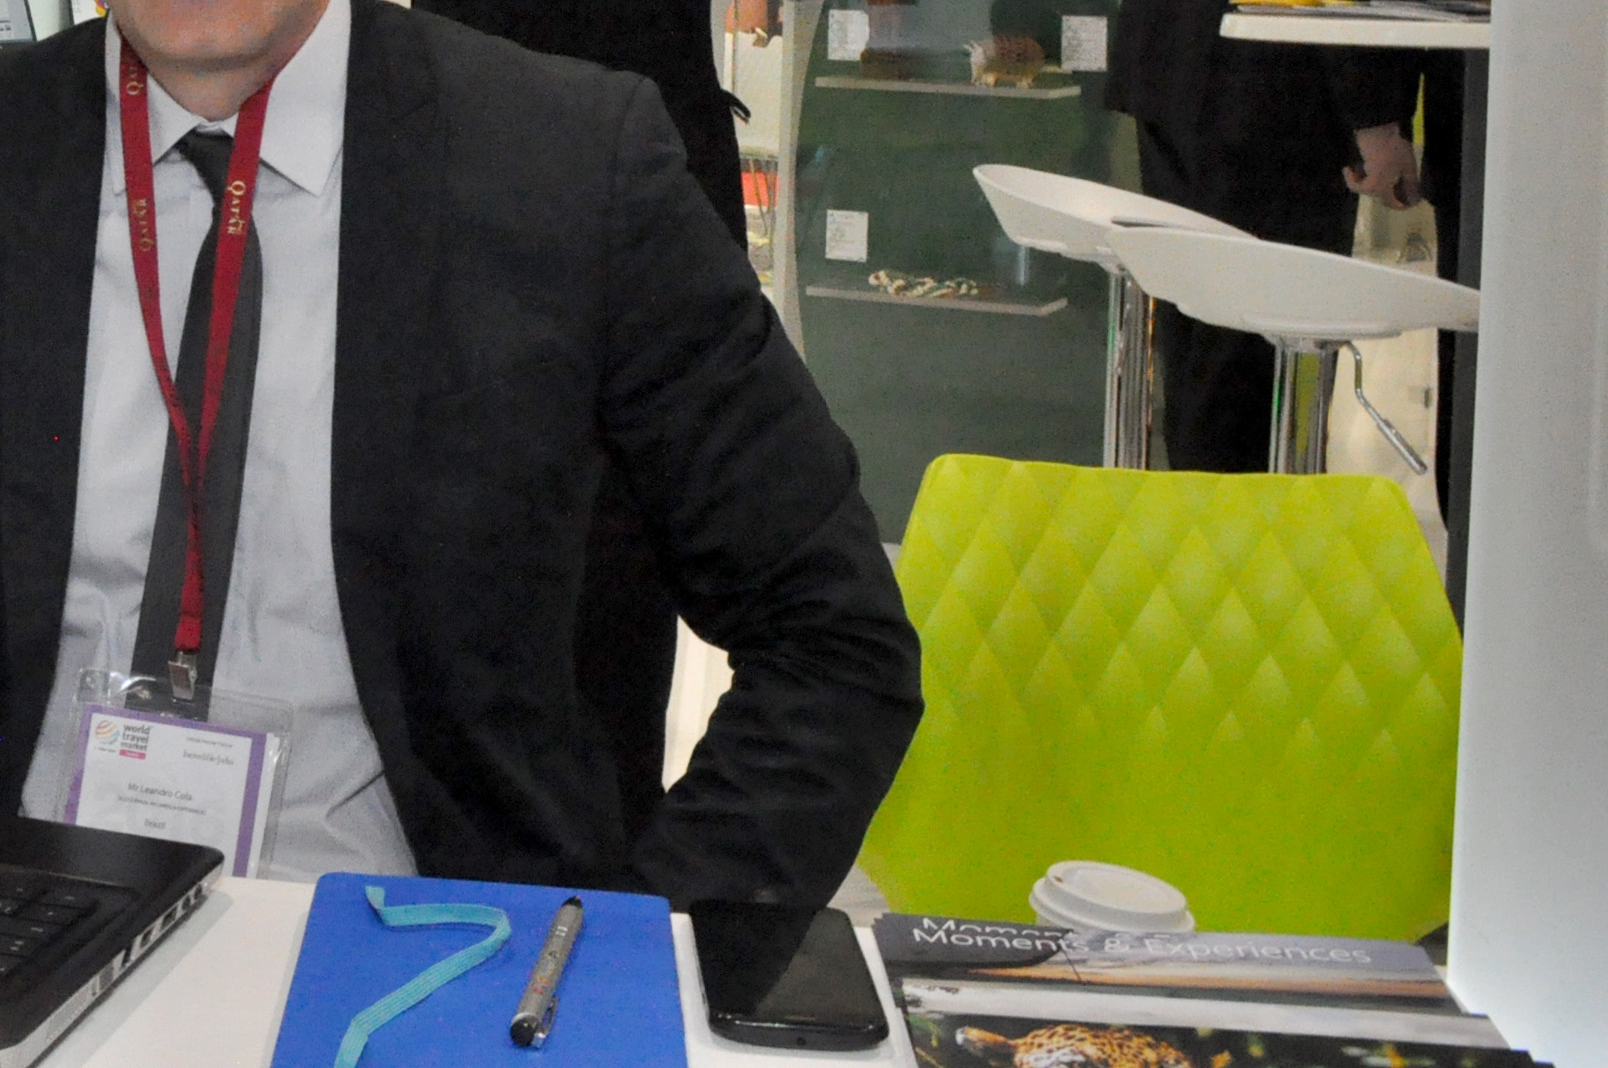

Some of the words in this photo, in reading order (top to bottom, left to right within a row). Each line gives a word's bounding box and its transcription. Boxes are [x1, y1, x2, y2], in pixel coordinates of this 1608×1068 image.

[122, 732, 150, 744] travel
[140, 784, 173, 798] Leandro
[913, 928, 1090, 952] Moments
[1104, 937, 1131, 954] &
[1145, 939, 1373, 965] Experiences
